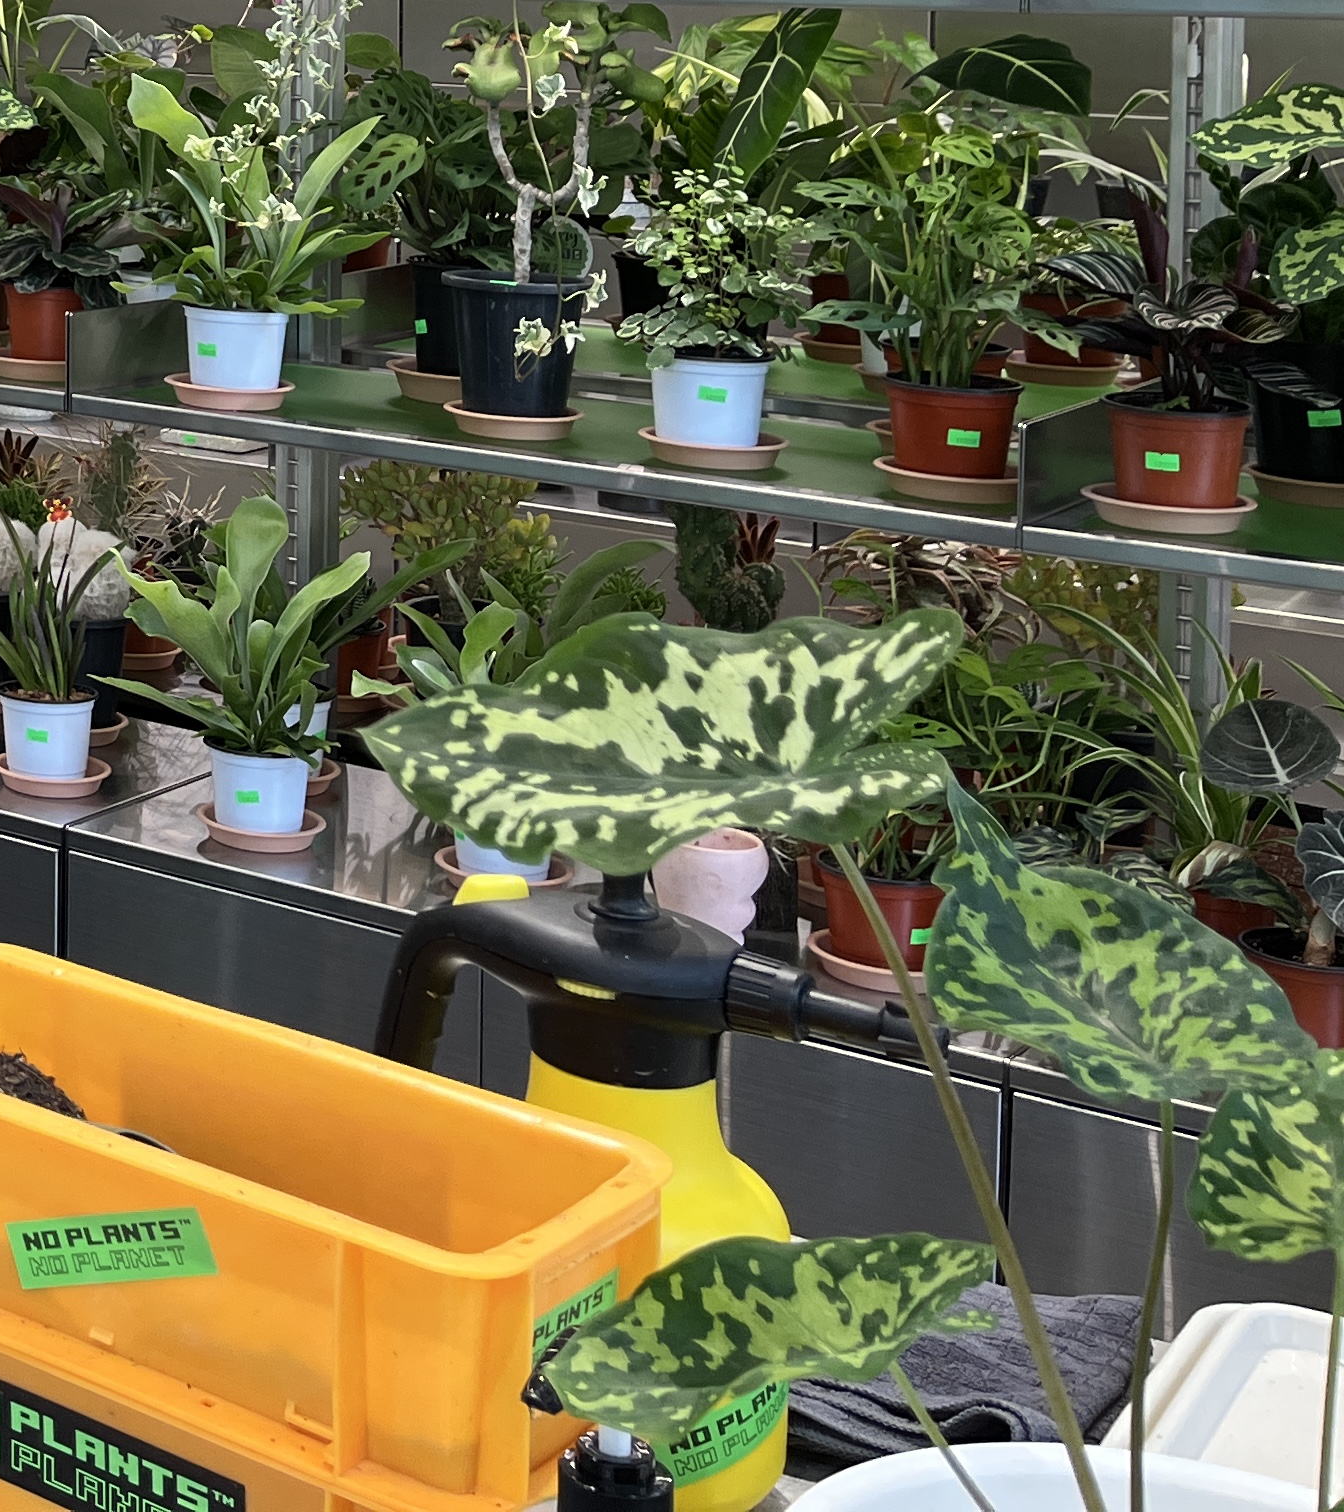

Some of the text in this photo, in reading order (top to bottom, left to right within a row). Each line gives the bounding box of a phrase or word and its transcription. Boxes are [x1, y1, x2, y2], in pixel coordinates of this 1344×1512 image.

[21, 1229, 62, 1251] NO
[28, 1245, 185, 1277] NO PLANET
[716, 1382, 777, 1436] PLAN
[10, 1438, 172, 1512] PLAN
[673, 1446, 719, 1477] NO
